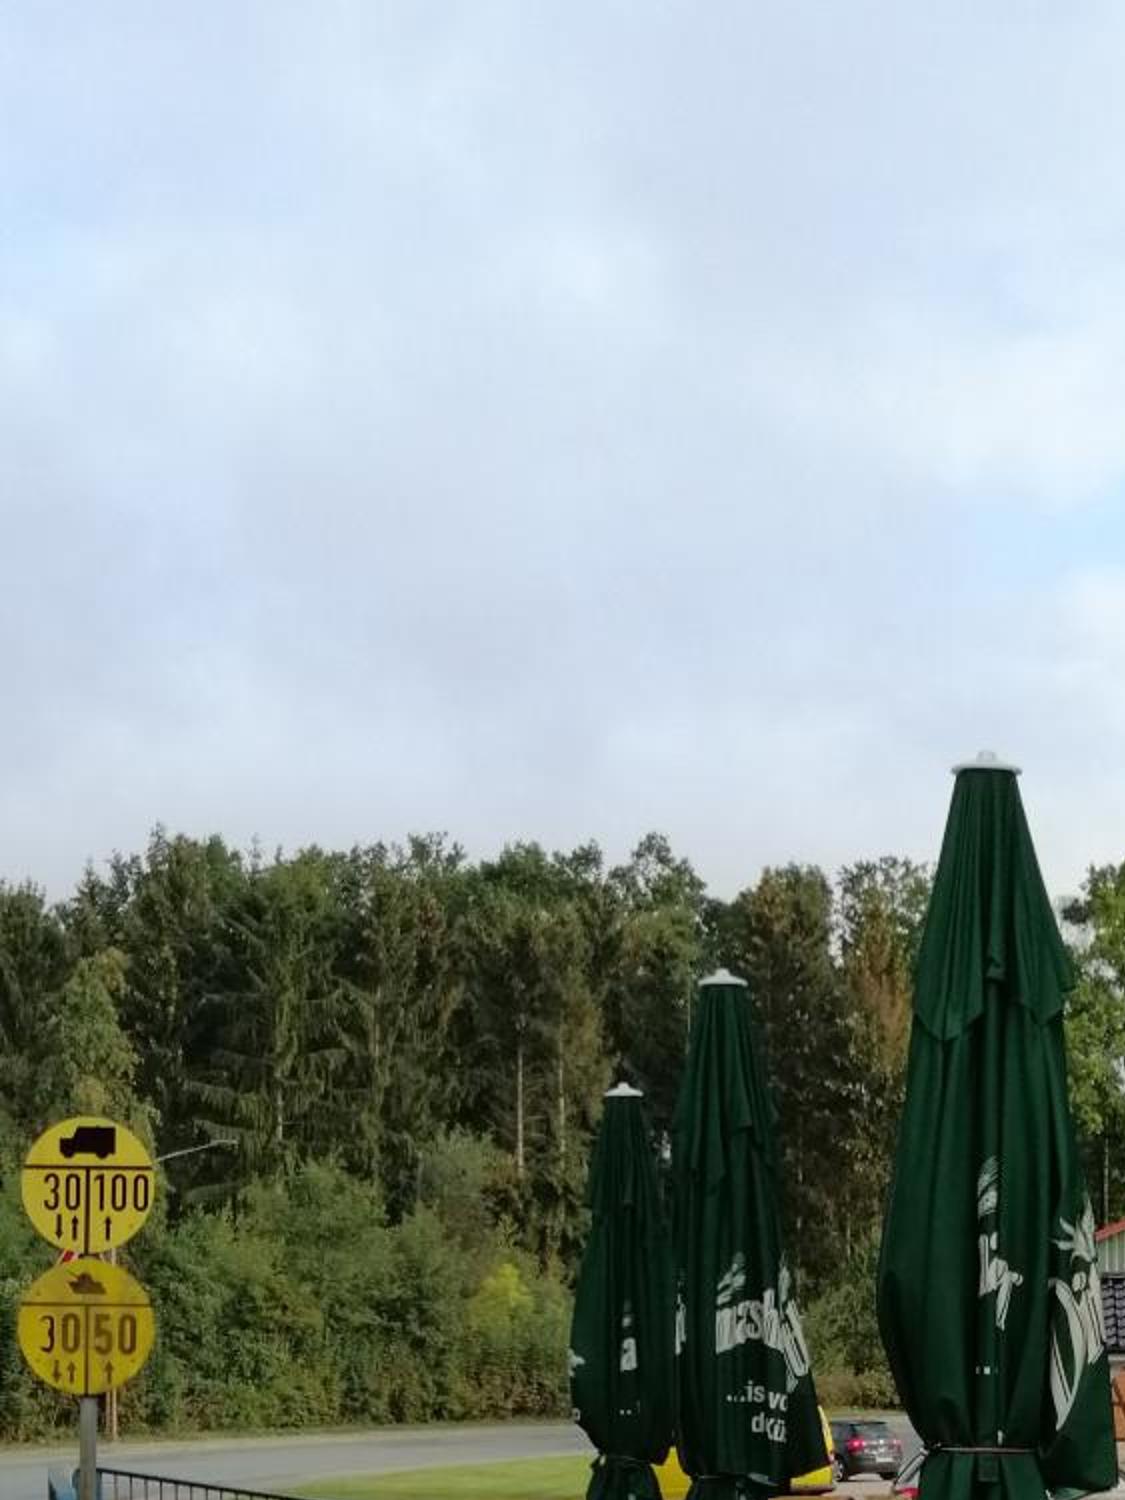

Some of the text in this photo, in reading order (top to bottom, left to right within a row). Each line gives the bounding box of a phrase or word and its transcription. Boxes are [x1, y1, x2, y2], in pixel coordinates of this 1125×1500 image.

[44, 1173, 149, 1212] 30 100
[40, 1313, 137, 1355] 30 50
